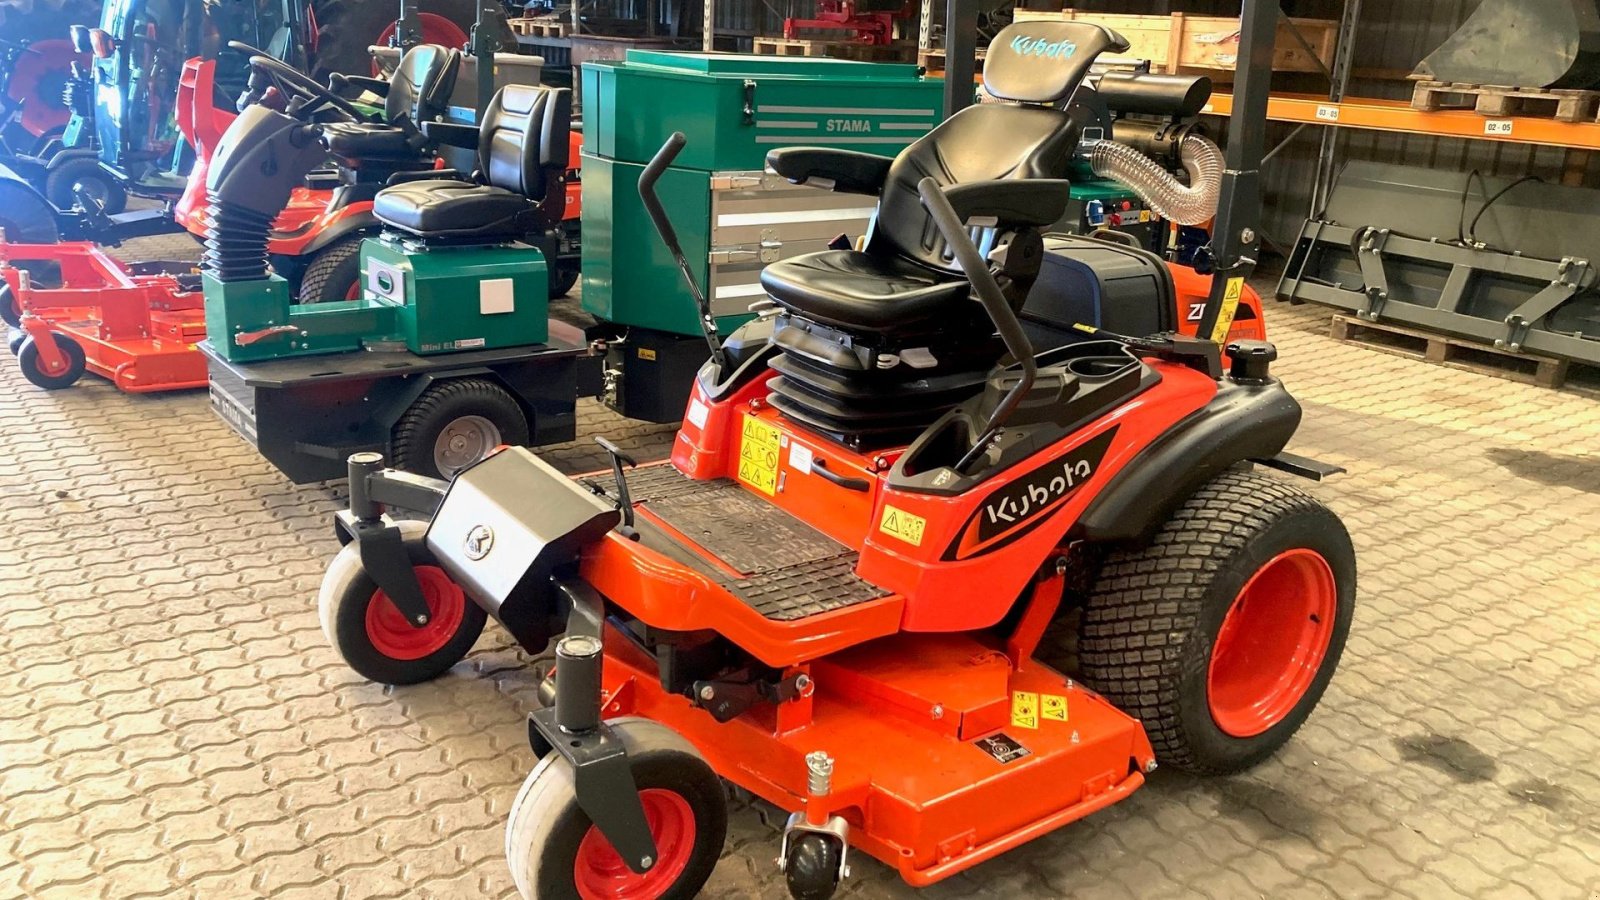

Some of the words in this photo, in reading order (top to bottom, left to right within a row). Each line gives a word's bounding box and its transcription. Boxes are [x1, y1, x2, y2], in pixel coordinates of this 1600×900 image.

[1010, 35, 1077, 59] Kubota
[826, 119, 872, 132] STAMA
[1488, 123, 1497, 131] 02
[1502, 123, 1511, 131] 05
[421, 343, 441, 352] Mini
[987, 459, 1091, 524] Kubota
